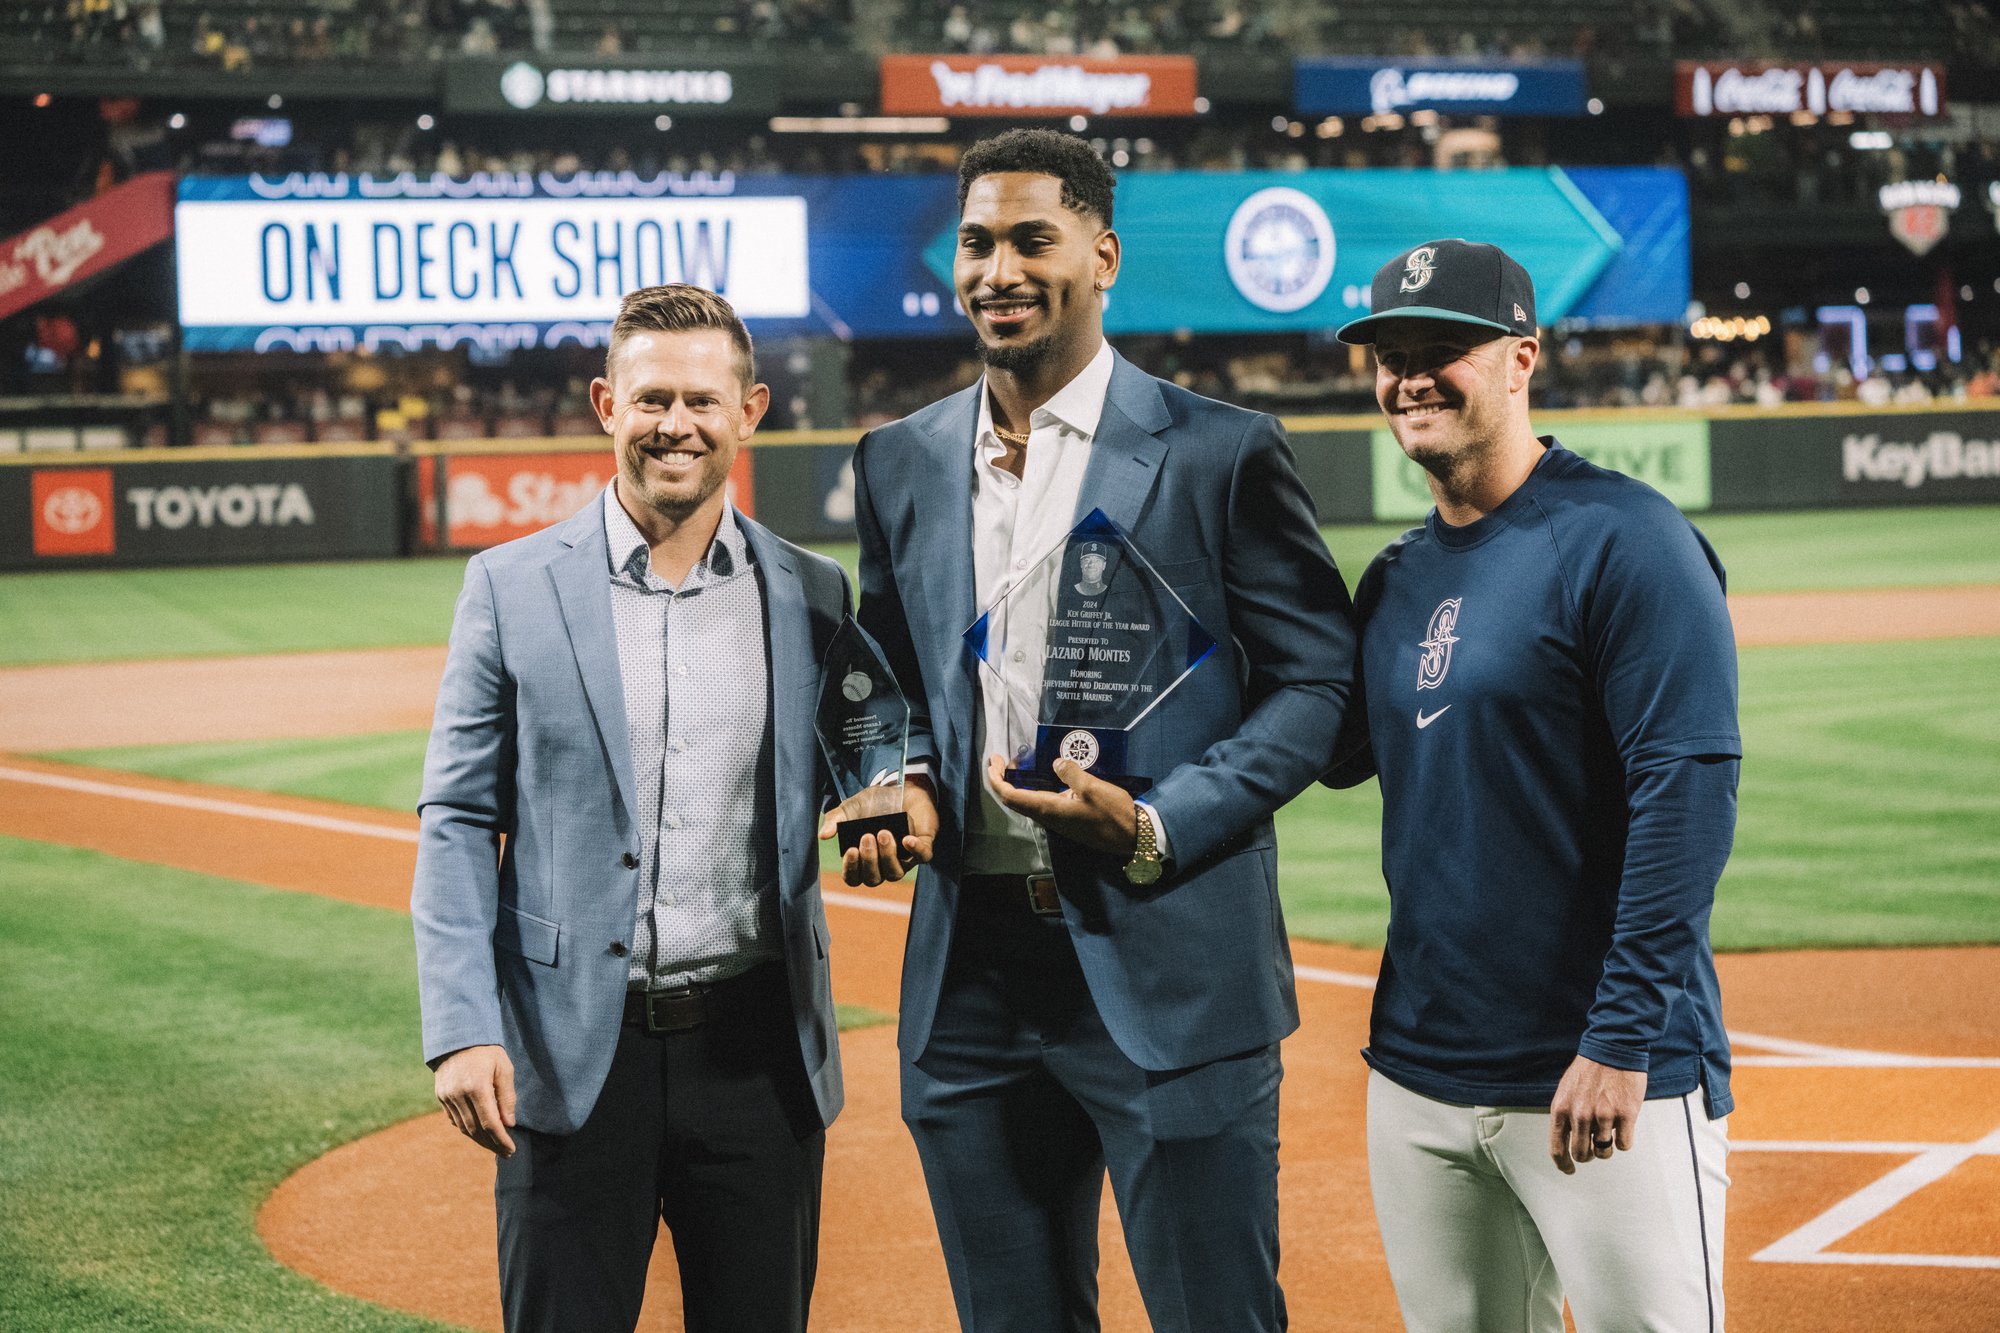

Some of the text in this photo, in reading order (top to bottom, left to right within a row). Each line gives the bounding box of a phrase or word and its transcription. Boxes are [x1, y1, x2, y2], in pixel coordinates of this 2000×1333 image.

[262, 220, 731, 301] ON DECK SHOW
[126, 484, 315, 530] TOYOTA
[1067, 610, 1078, 618] KEN
[1080, 611, 1103, 619] GRIFFEY
[1050, 619, 1069, 627] LEAGUE
[1071, 620, 1091, 628] HITTER
[1115, 622, 1129, 630] YEAR
[1130, 623, 1150, 631] AWARD
[1068, 636, 1098, 645] PRESENTED
[1046, 645, 1130, 662] LAZARO MONTES
[1070, 669, 1102, 678] HONORING
[1040, 680, 1078, 688] CHIEVEMENT
[1079, 681, 1091, 689] AND
[1093, 681, 1128, 691] DEDICATION
[1131, 684, 1139, 692] TO
[1056, 691, 1112, 701] SEATTLE MARINERS
